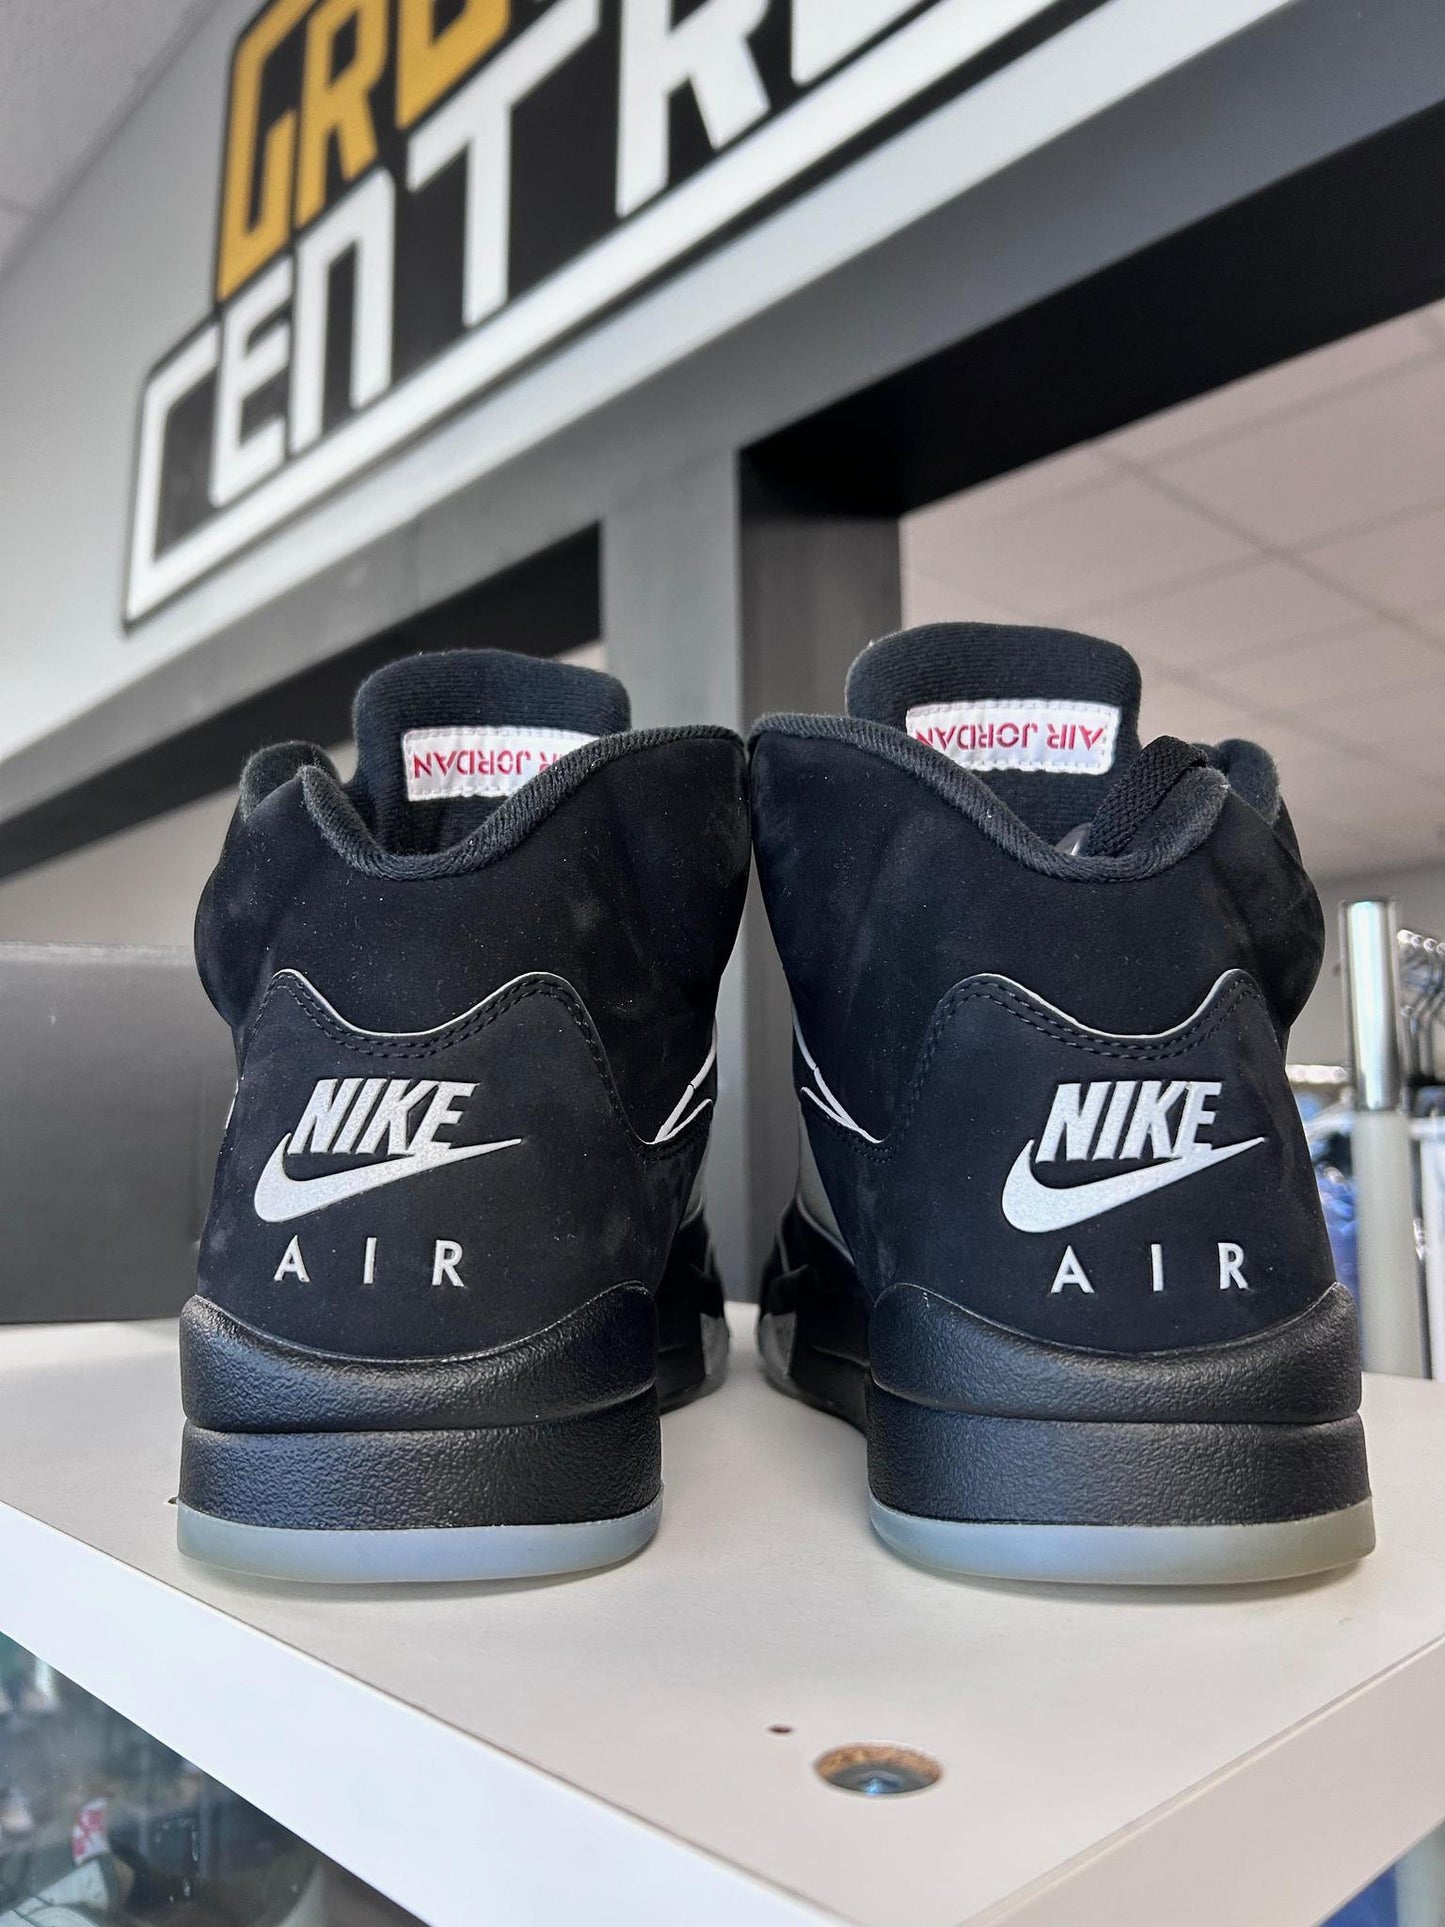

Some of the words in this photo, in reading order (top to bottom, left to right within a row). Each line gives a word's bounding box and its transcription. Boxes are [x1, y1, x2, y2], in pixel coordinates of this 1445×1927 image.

[1046, 723, 1104, 751] AIR
[413, 749, 531, 779] JORDAN
[287, 1077, 480, 1156] NIKE
[1035, 1080, 1222, 1163] NIKE
[273, 1234, 465, 1287] AIR
[1050, 1242, 1250, 1294] AIR
